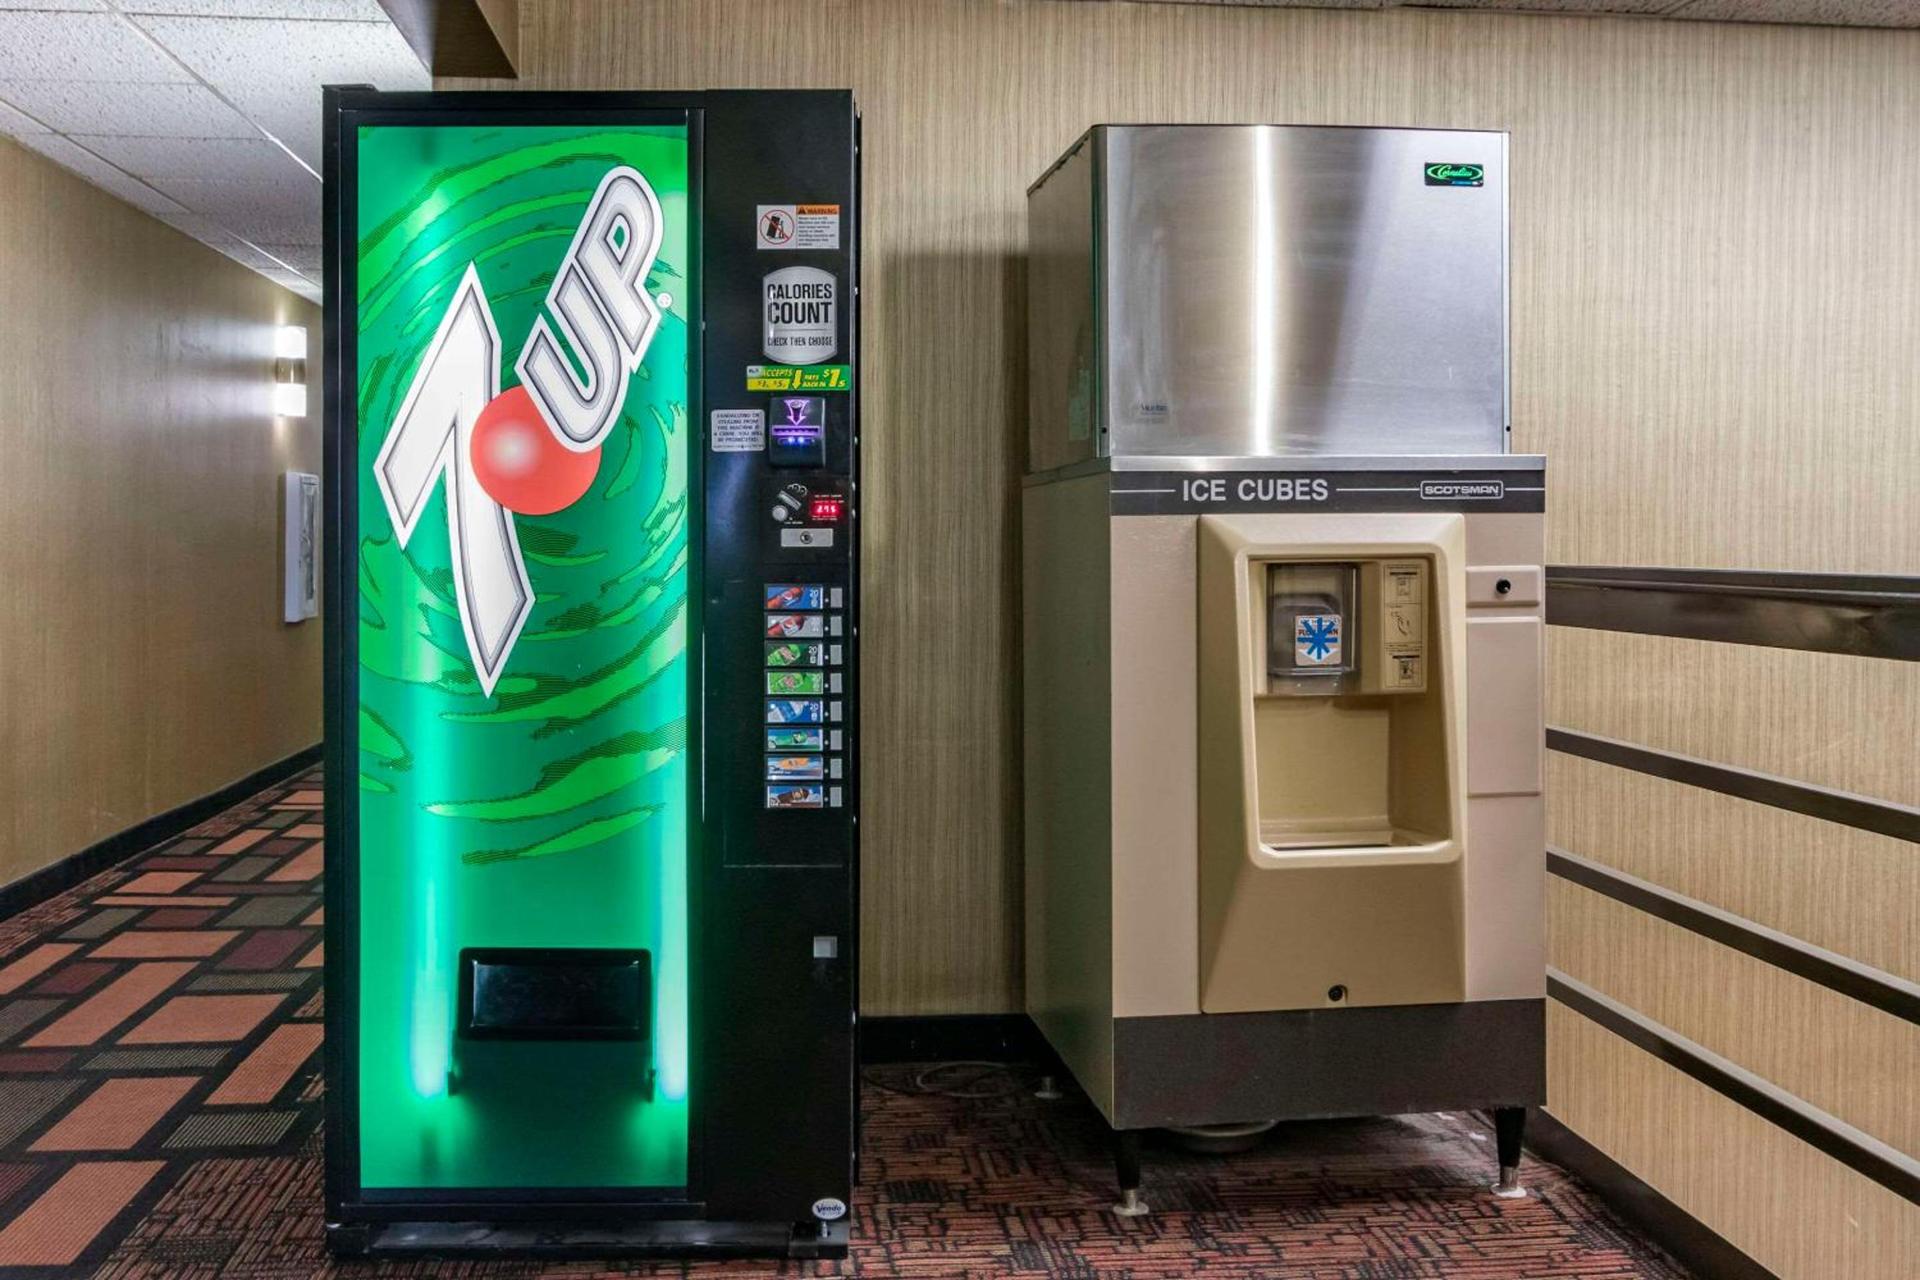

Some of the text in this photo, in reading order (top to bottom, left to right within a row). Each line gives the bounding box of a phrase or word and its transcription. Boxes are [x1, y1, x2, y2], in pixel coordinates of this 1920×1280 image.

[767, 283, 833, 300] CALORIES
[767, 302, 832, 324] COUNT
[767, 336, 833, 346] CHECK THEN CHOOSE
[1183, 479, 1328, 501] ICE CUBES
[1424, 485, 1499, 495] SCOTSMAN
